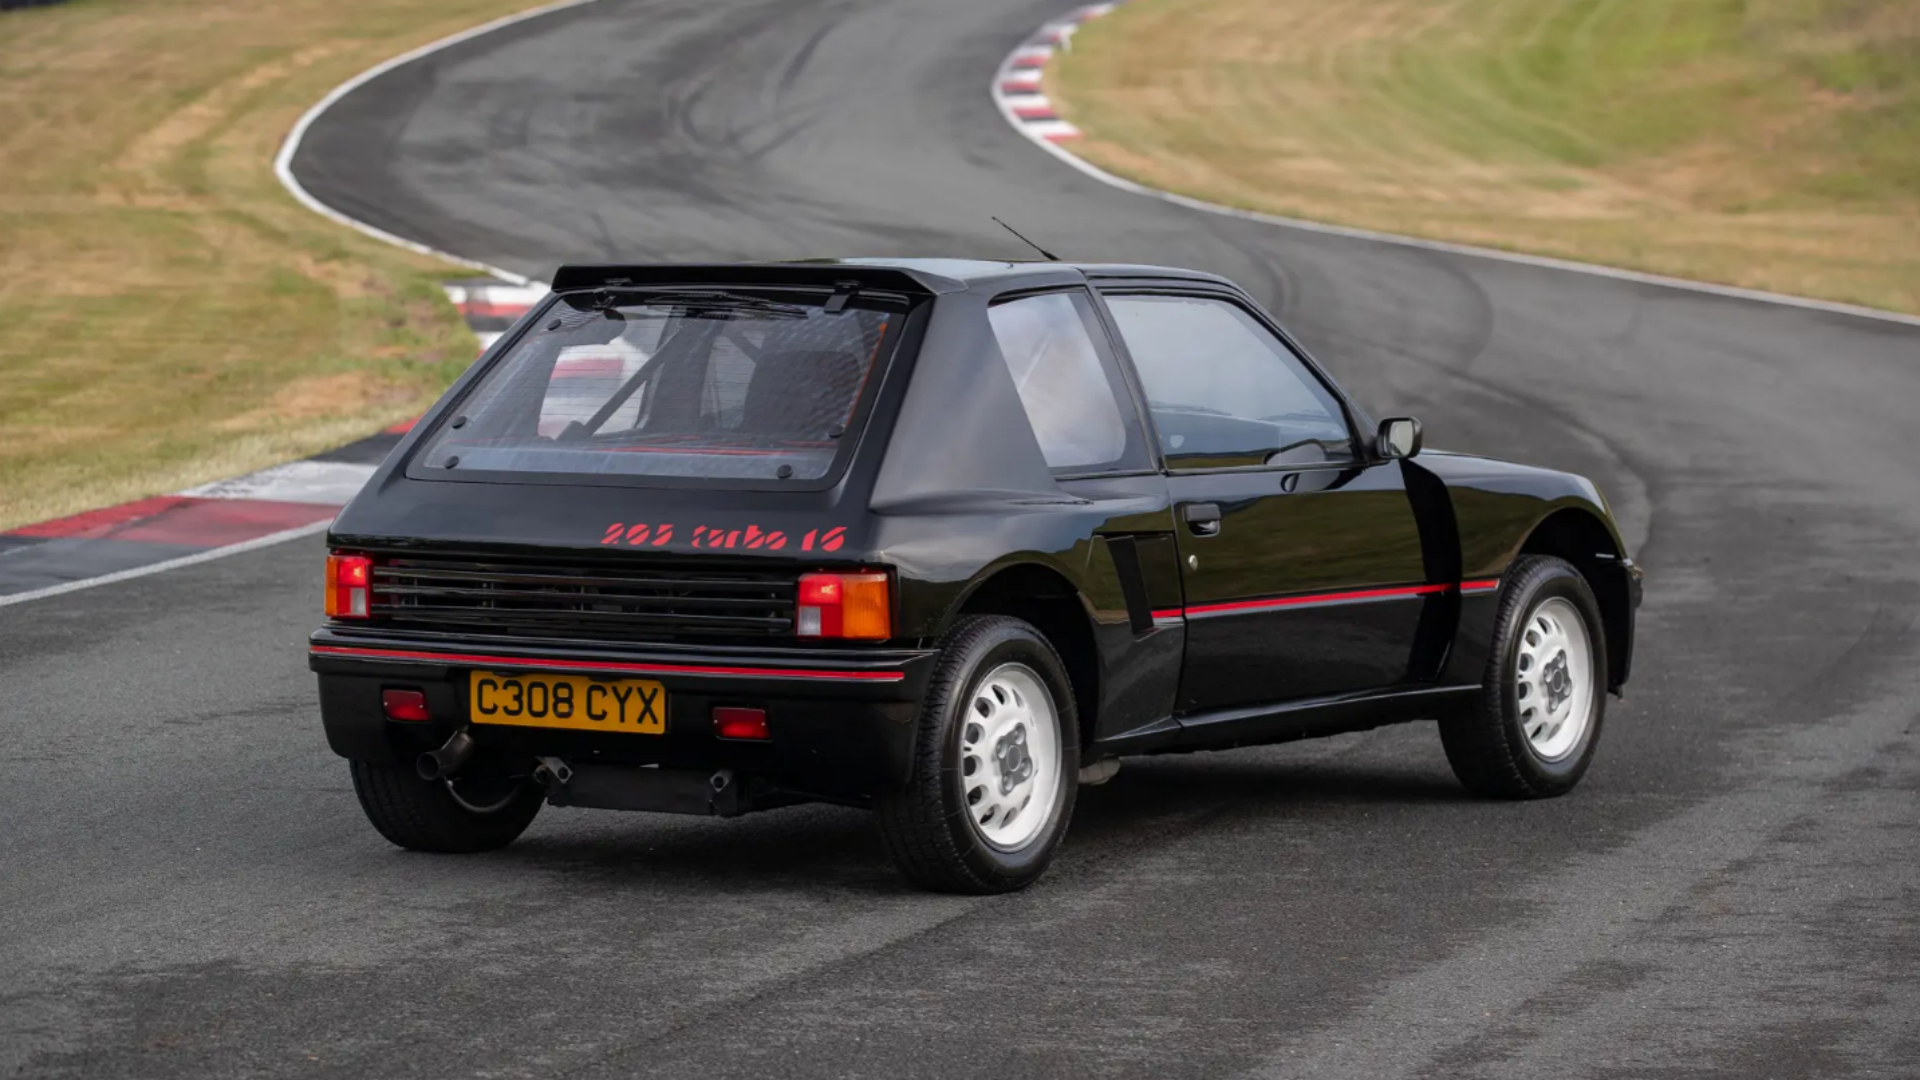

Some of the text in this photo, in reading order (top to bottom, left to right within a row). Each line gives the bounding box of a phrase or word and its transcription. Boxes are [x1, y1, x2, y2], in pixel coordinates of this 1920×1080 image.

[601, 523, 848, 551] 205 turbo 16
[477, 678, 659, 724] C308 CYX
